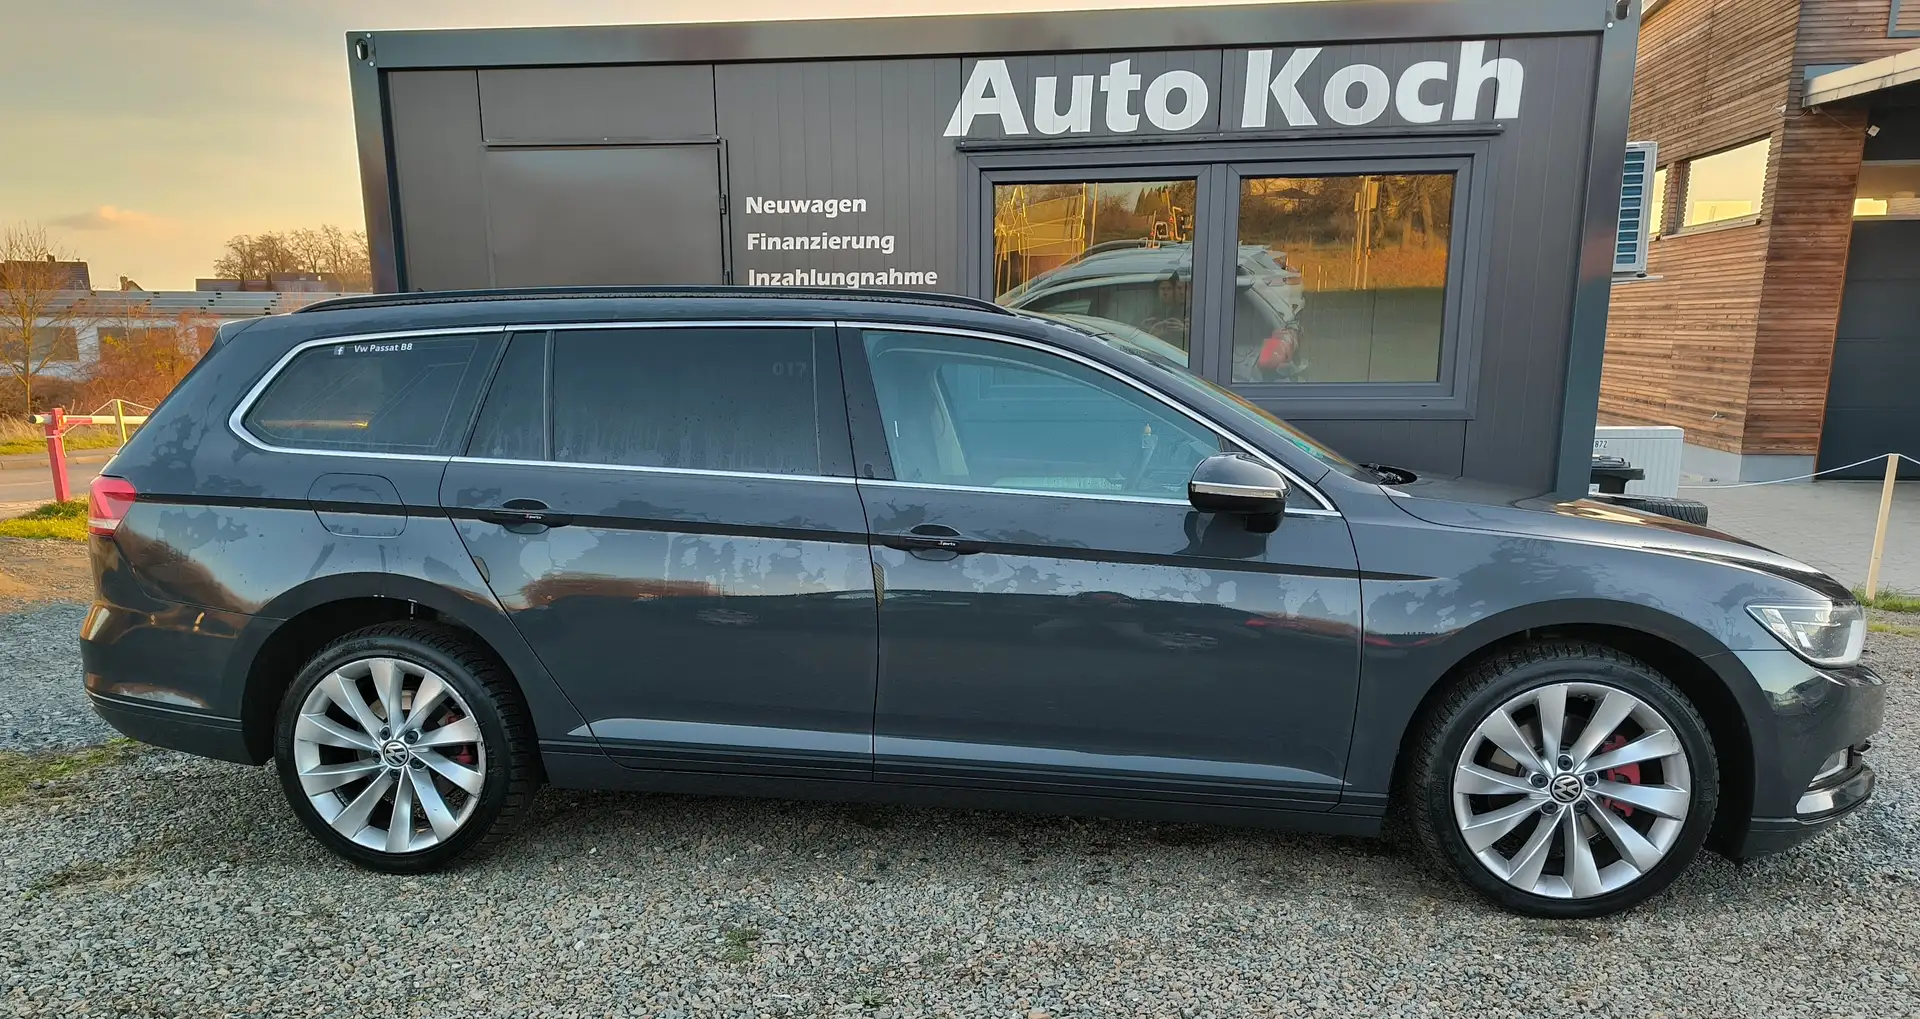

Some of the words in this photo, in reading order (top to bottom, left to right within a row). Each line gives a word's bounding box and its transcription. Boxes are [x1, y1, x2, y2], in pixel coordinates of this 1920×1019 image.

[942, 58, 1209, 137] Auto
[1241, 40, 1525, 128] Koch
[745, 196, 867, 218] Neuwagen
[747, 232, 895, 254] Finanzierung
[748, 268, 938, 288] Inzahlungnahme
[354, 344, 368, 353] Vw
[369, 344, 399, 352] Passat
[400, 342, 413, 351] B8
